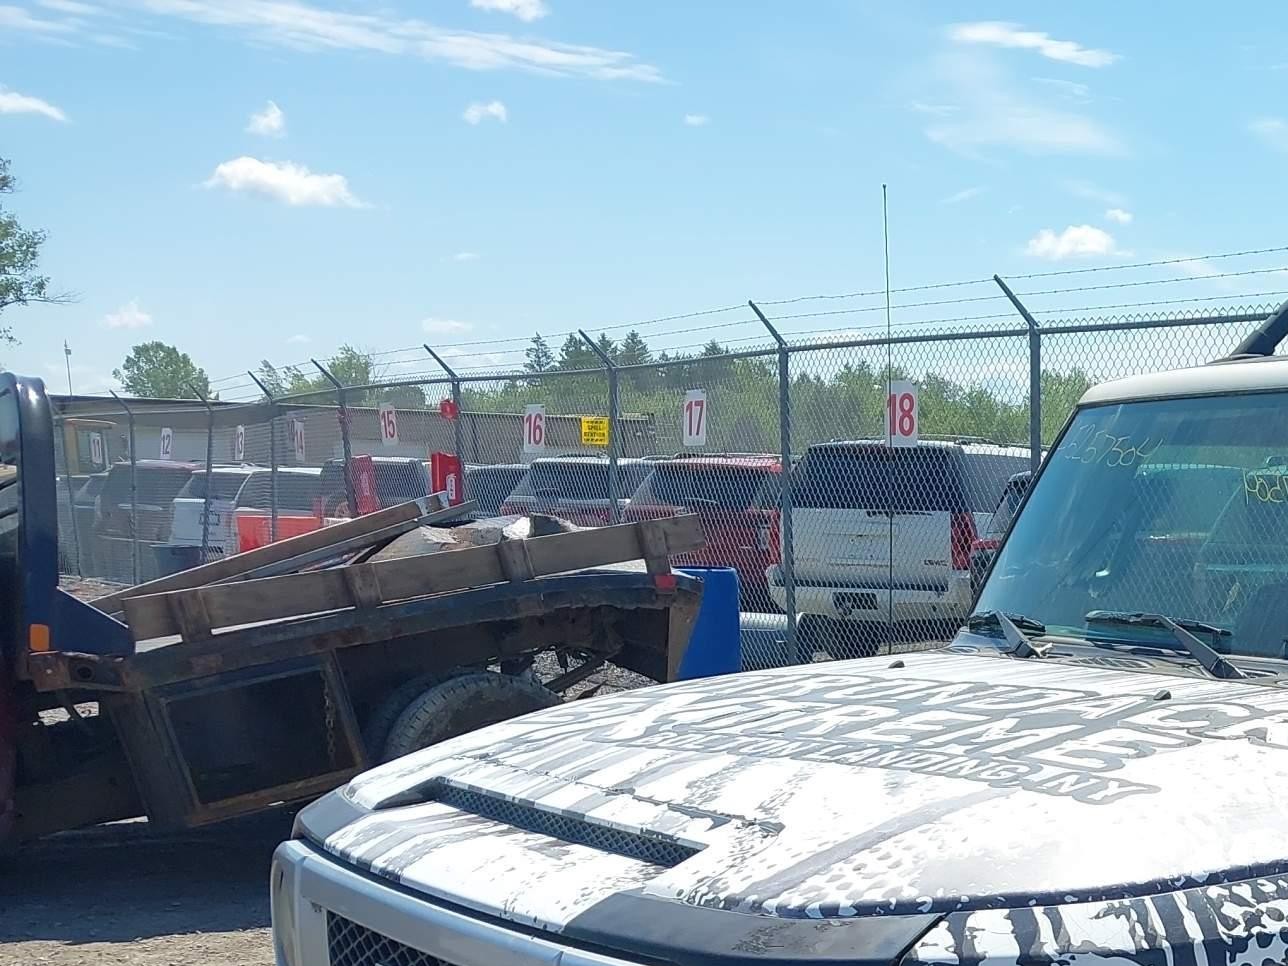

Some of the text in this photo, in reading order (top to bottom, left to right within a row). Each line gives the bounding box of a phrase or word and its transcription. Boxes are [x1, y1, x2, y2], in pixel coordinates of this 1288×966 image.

[379, 410, 397, 440] 15
[525, 412, 543, 446] 16
[683, 399, 705, 438] 17
[886, 392, 915, 438] 18
[161, 433, 172, 456] 12
[1045, 772, 1145, 800] NY
